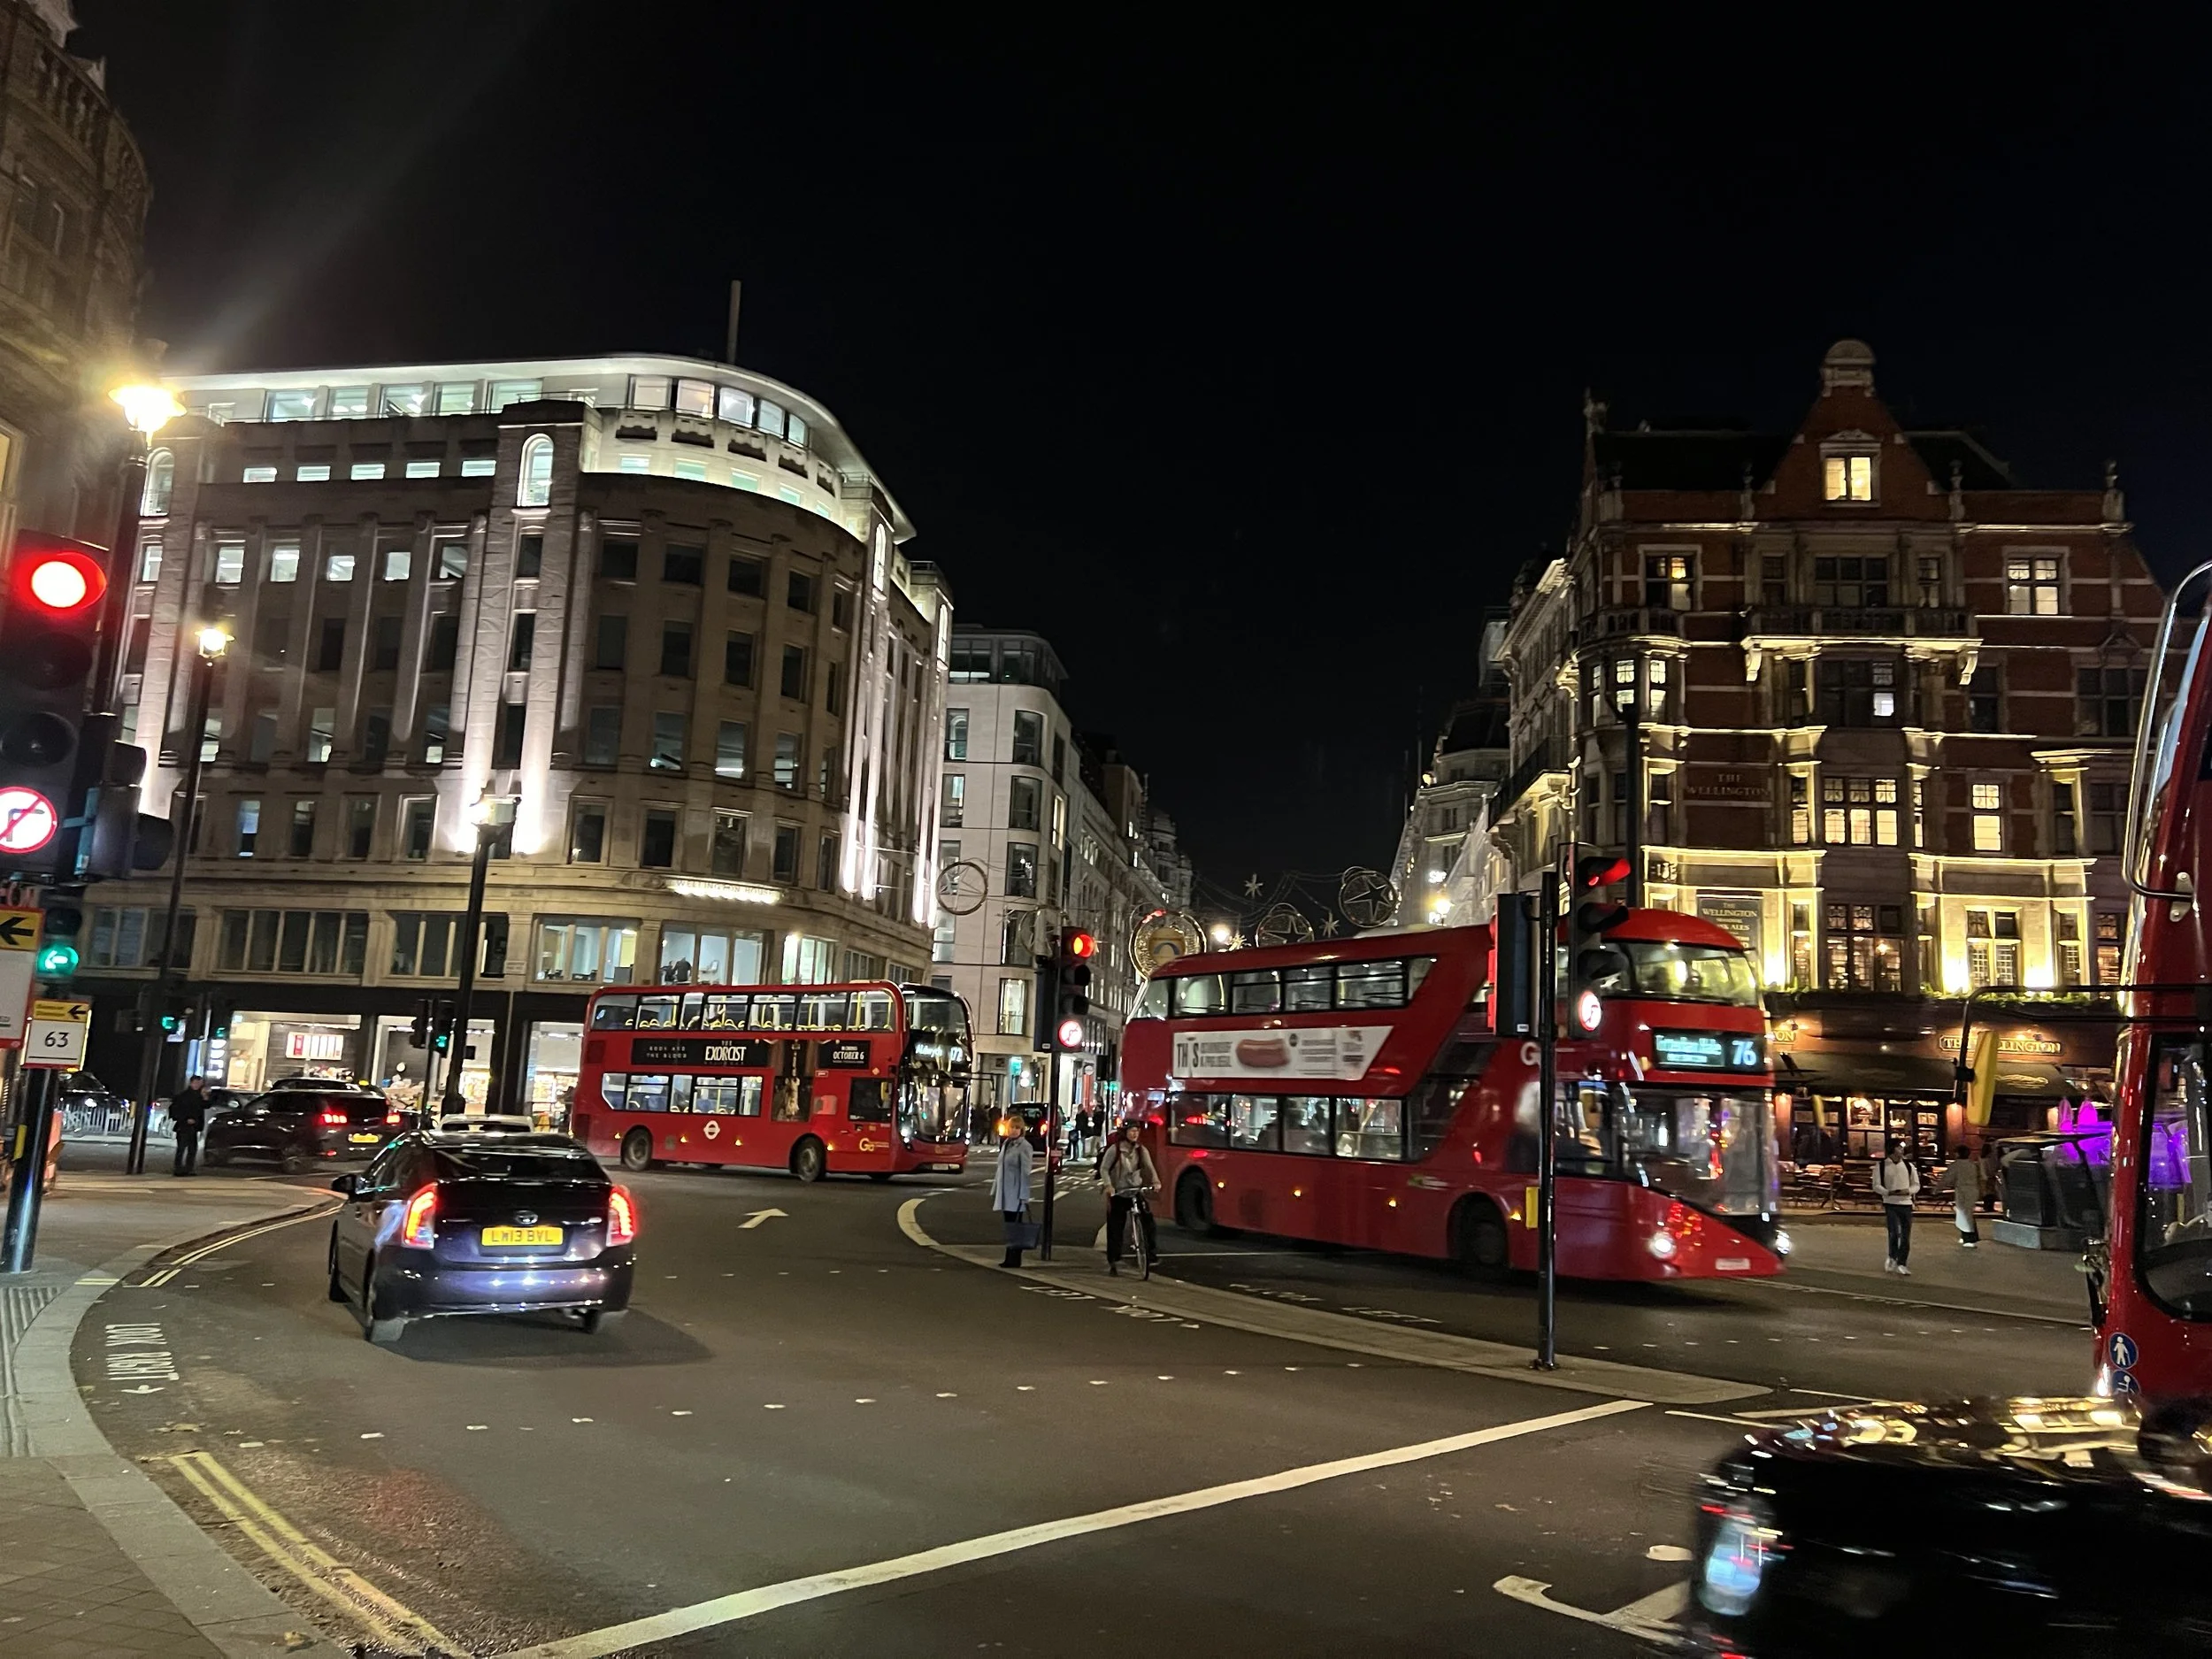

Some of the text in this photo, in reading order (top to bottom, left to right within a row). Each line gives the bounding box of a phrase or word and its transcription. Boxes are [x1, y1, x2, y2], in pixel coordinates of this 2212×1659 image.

[1717, 774, 1742, 783] THE
[1686, 786, 1771, 796] WELLINGTON
[1701, 908, 1758, 918] WELLINGTON
[44, 1031, 70, 1048] 63
[1732, 1039, 1756, 1066] 76
[1997, 1040, 2062, 1054] LINGTON
[704, 1046, 748, 1062] EXORCIST
[833, 1051, 864, 1060] OCTOBER 6
